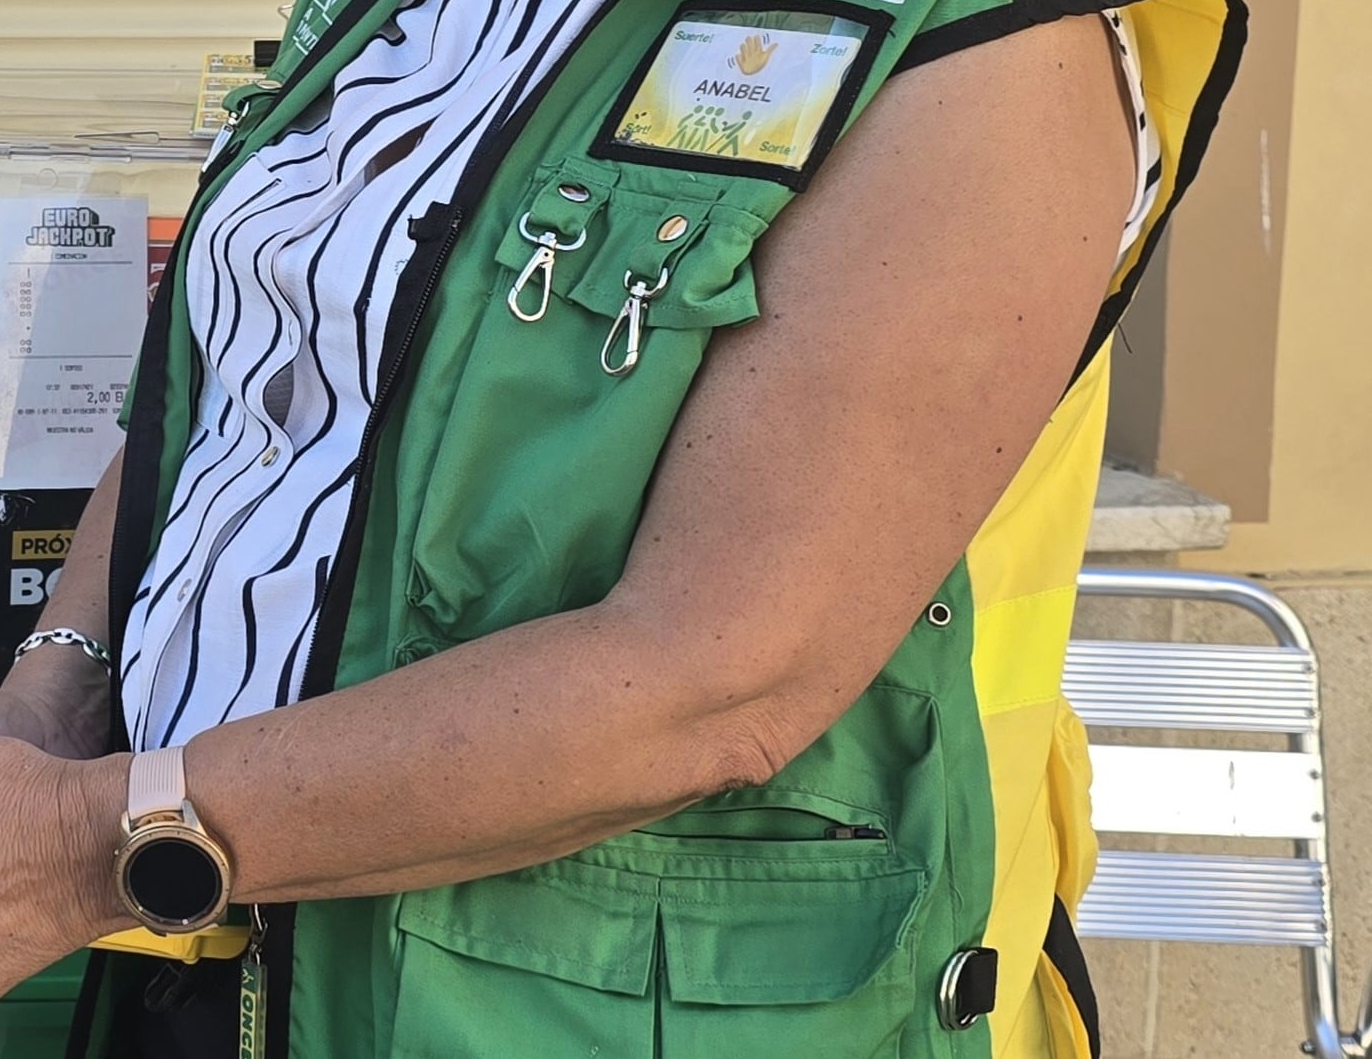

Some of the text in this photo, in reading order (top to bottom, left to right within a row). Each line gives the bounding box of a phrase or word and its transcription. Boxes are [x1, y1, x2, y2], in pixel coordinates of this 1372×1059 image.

[674, 30, 715, 44] Suerte!
[810, 44, 848, 57] Zorte!
[693, 80, 771, 102] ANABEL
[759, 141, 796, 155] Sorte!
[43, 207, 99, 227] EURO
[26, 226, 115, 247] JACKPOT
[87, 392, 110, 404] 2,00
